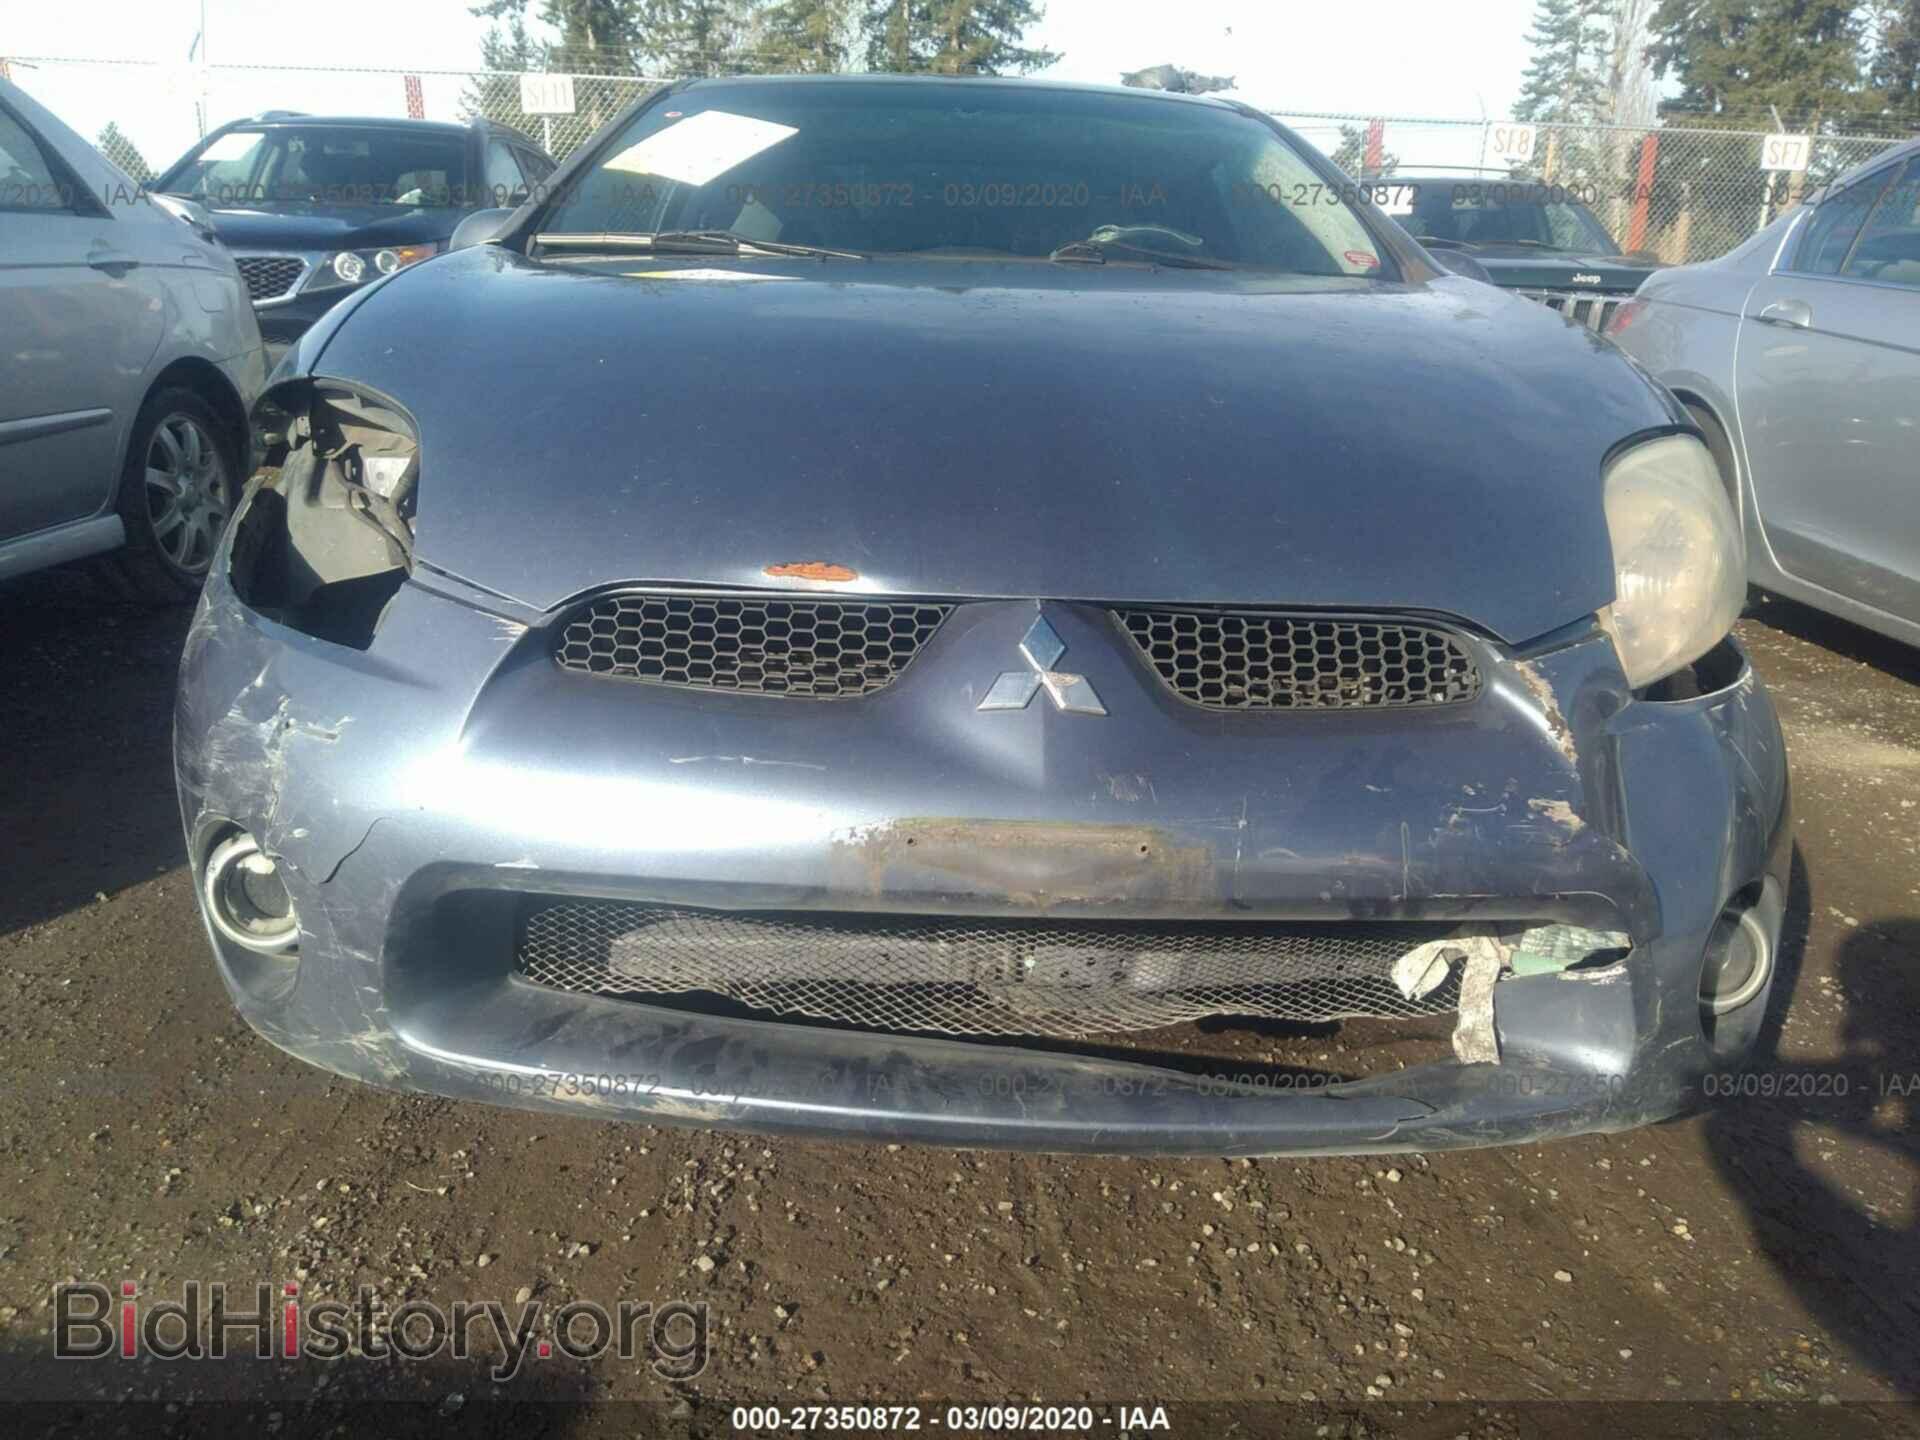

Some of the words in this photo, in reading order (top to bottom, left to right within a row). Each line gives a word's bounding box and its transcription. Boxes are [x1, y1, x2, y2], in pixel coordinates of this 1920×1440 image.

[1493, 128, 1530, 154] SF8
[1768, 140, 1802, 165] SF7
[1572, 273, 1601, 284] Jeep
